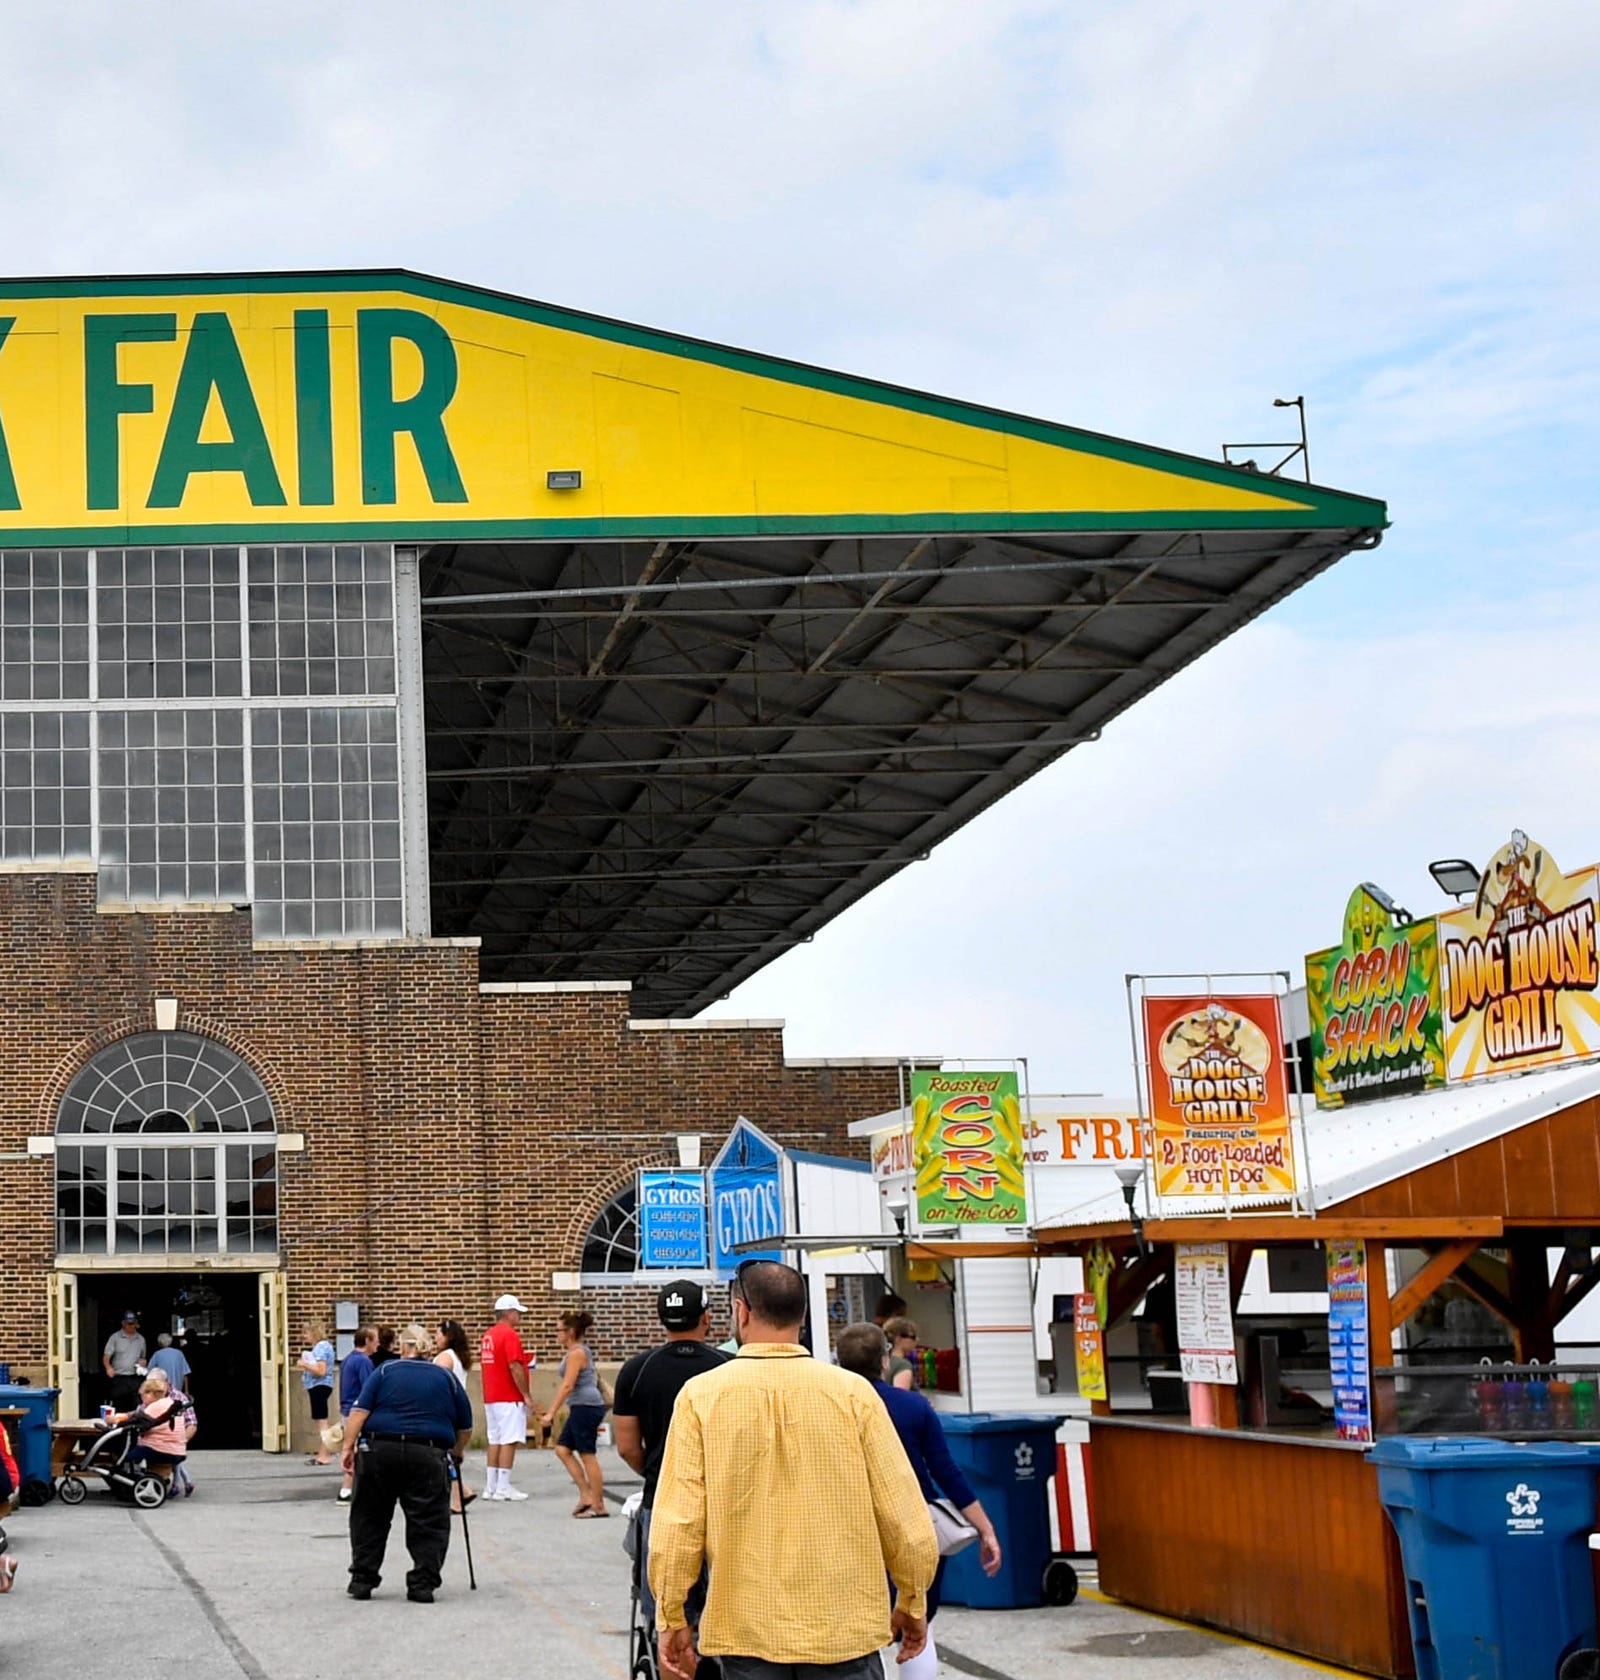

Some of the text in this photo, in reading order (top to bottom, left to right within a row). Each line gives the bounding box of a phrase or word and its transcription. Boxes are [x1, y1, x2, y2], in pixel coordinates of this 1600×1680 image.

[82, 307, 470, 511] FAIR
[1507, 905, 1527, 928] THE
[1447, 902, 1598, 1019] DOG HOUSE
[1331, 939, 1411, 1011] CORN
[1324, 992, 1430, 1072] SHACK
[1485, 989, 1562, 1060] GRILL
[1188, 1057, 1242, 1079] DOG
[929, 1075, 1002, 1093] Roasted
[1171, 1076, 1266, 1104] HOUSE
[1184, 1100, 1256, 1124] GRILL
[1186, 1129, 1257, 1140] Featuring the
[940, 1094, 1000, 1203] CORN
[1163, 1139, 1176, 1165] 2
[1186, 1168, 1264, 1184] HOT DOG
[646, 1188, 701, 1205] GYROS
[717, 1180, 779, 1255] GYROS
